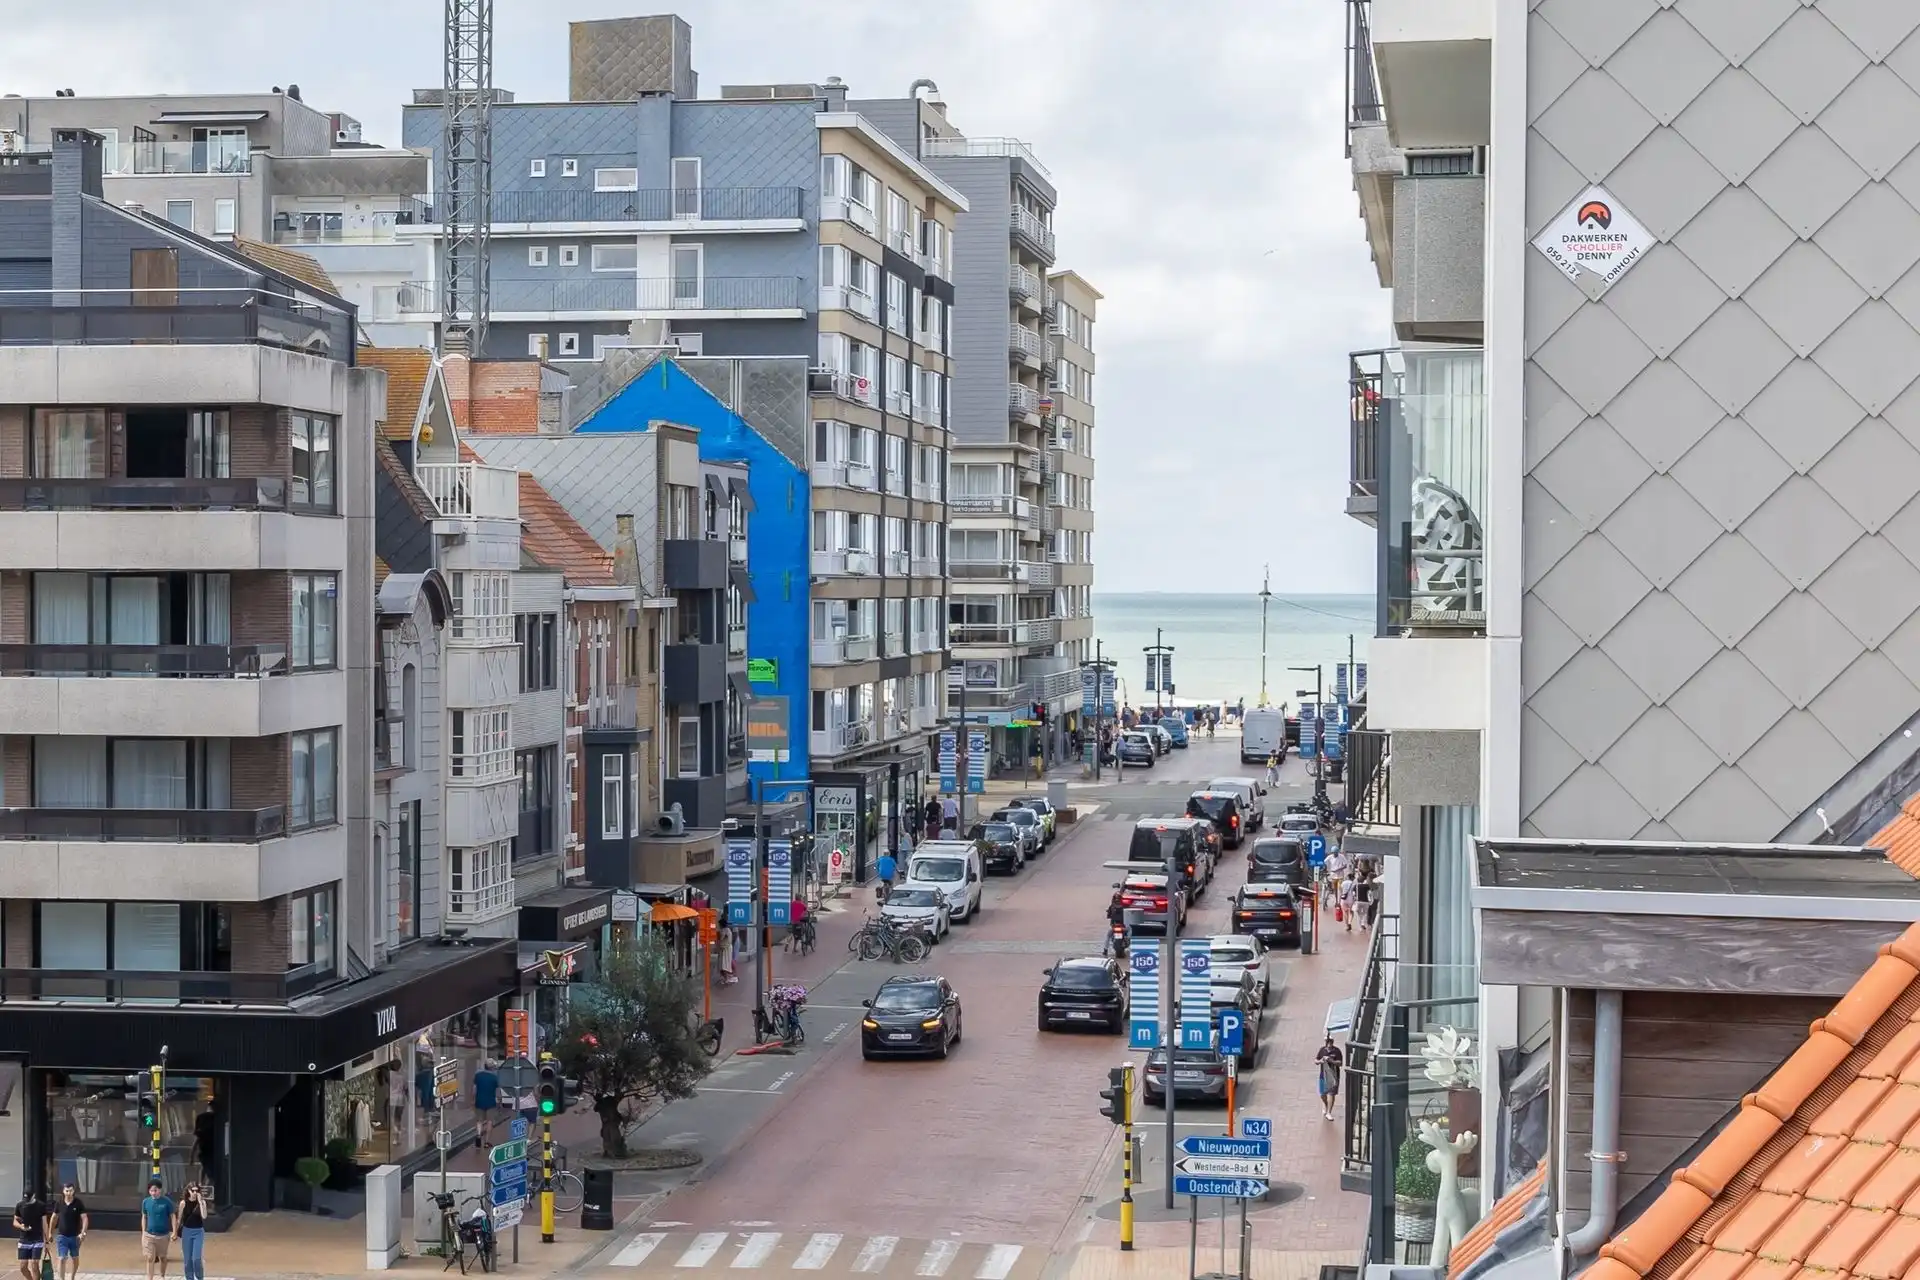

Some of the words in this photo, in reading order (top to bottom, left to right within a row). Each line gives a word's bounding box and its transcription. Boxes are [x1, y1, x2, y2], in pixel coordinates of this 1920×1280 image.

[1562, 234, 1628, 243] DAKWERKEN
[1566, 244, 1623, 252] SCHOLLIER
[1546, 246, 1562, 262] 050
[1560, 259, 1576, 274] 213
[1577, 252, 1613, 261] DENNY
[1602, 246, 1640, 285] TORHOUT
[1311, 840, 1322, 855] P
[733, 852, 746, 861] 150
[772, 852, 787, 861] 150
[735, 908, 745, 918] m
[774, 908, 784, 918] m
[1135, 956, 1154, 967] 150
[1187, 957, 1205, 968] 150
[375, 1006, 397, 1036] VIVA
[1223, 1016, 1239, 1039] P
[1138, 1028, 1151, 1040] m
[1189, 1029, 1202, 1041] m
[1246, 1122, 1267, 1135] N34
[1198, 1140, 1260, 1156] Nieuwpoort
[1194, 1162, 1248, 1172] Westende-Bad
[1189, 1180, 1241, 1194] Oostende
